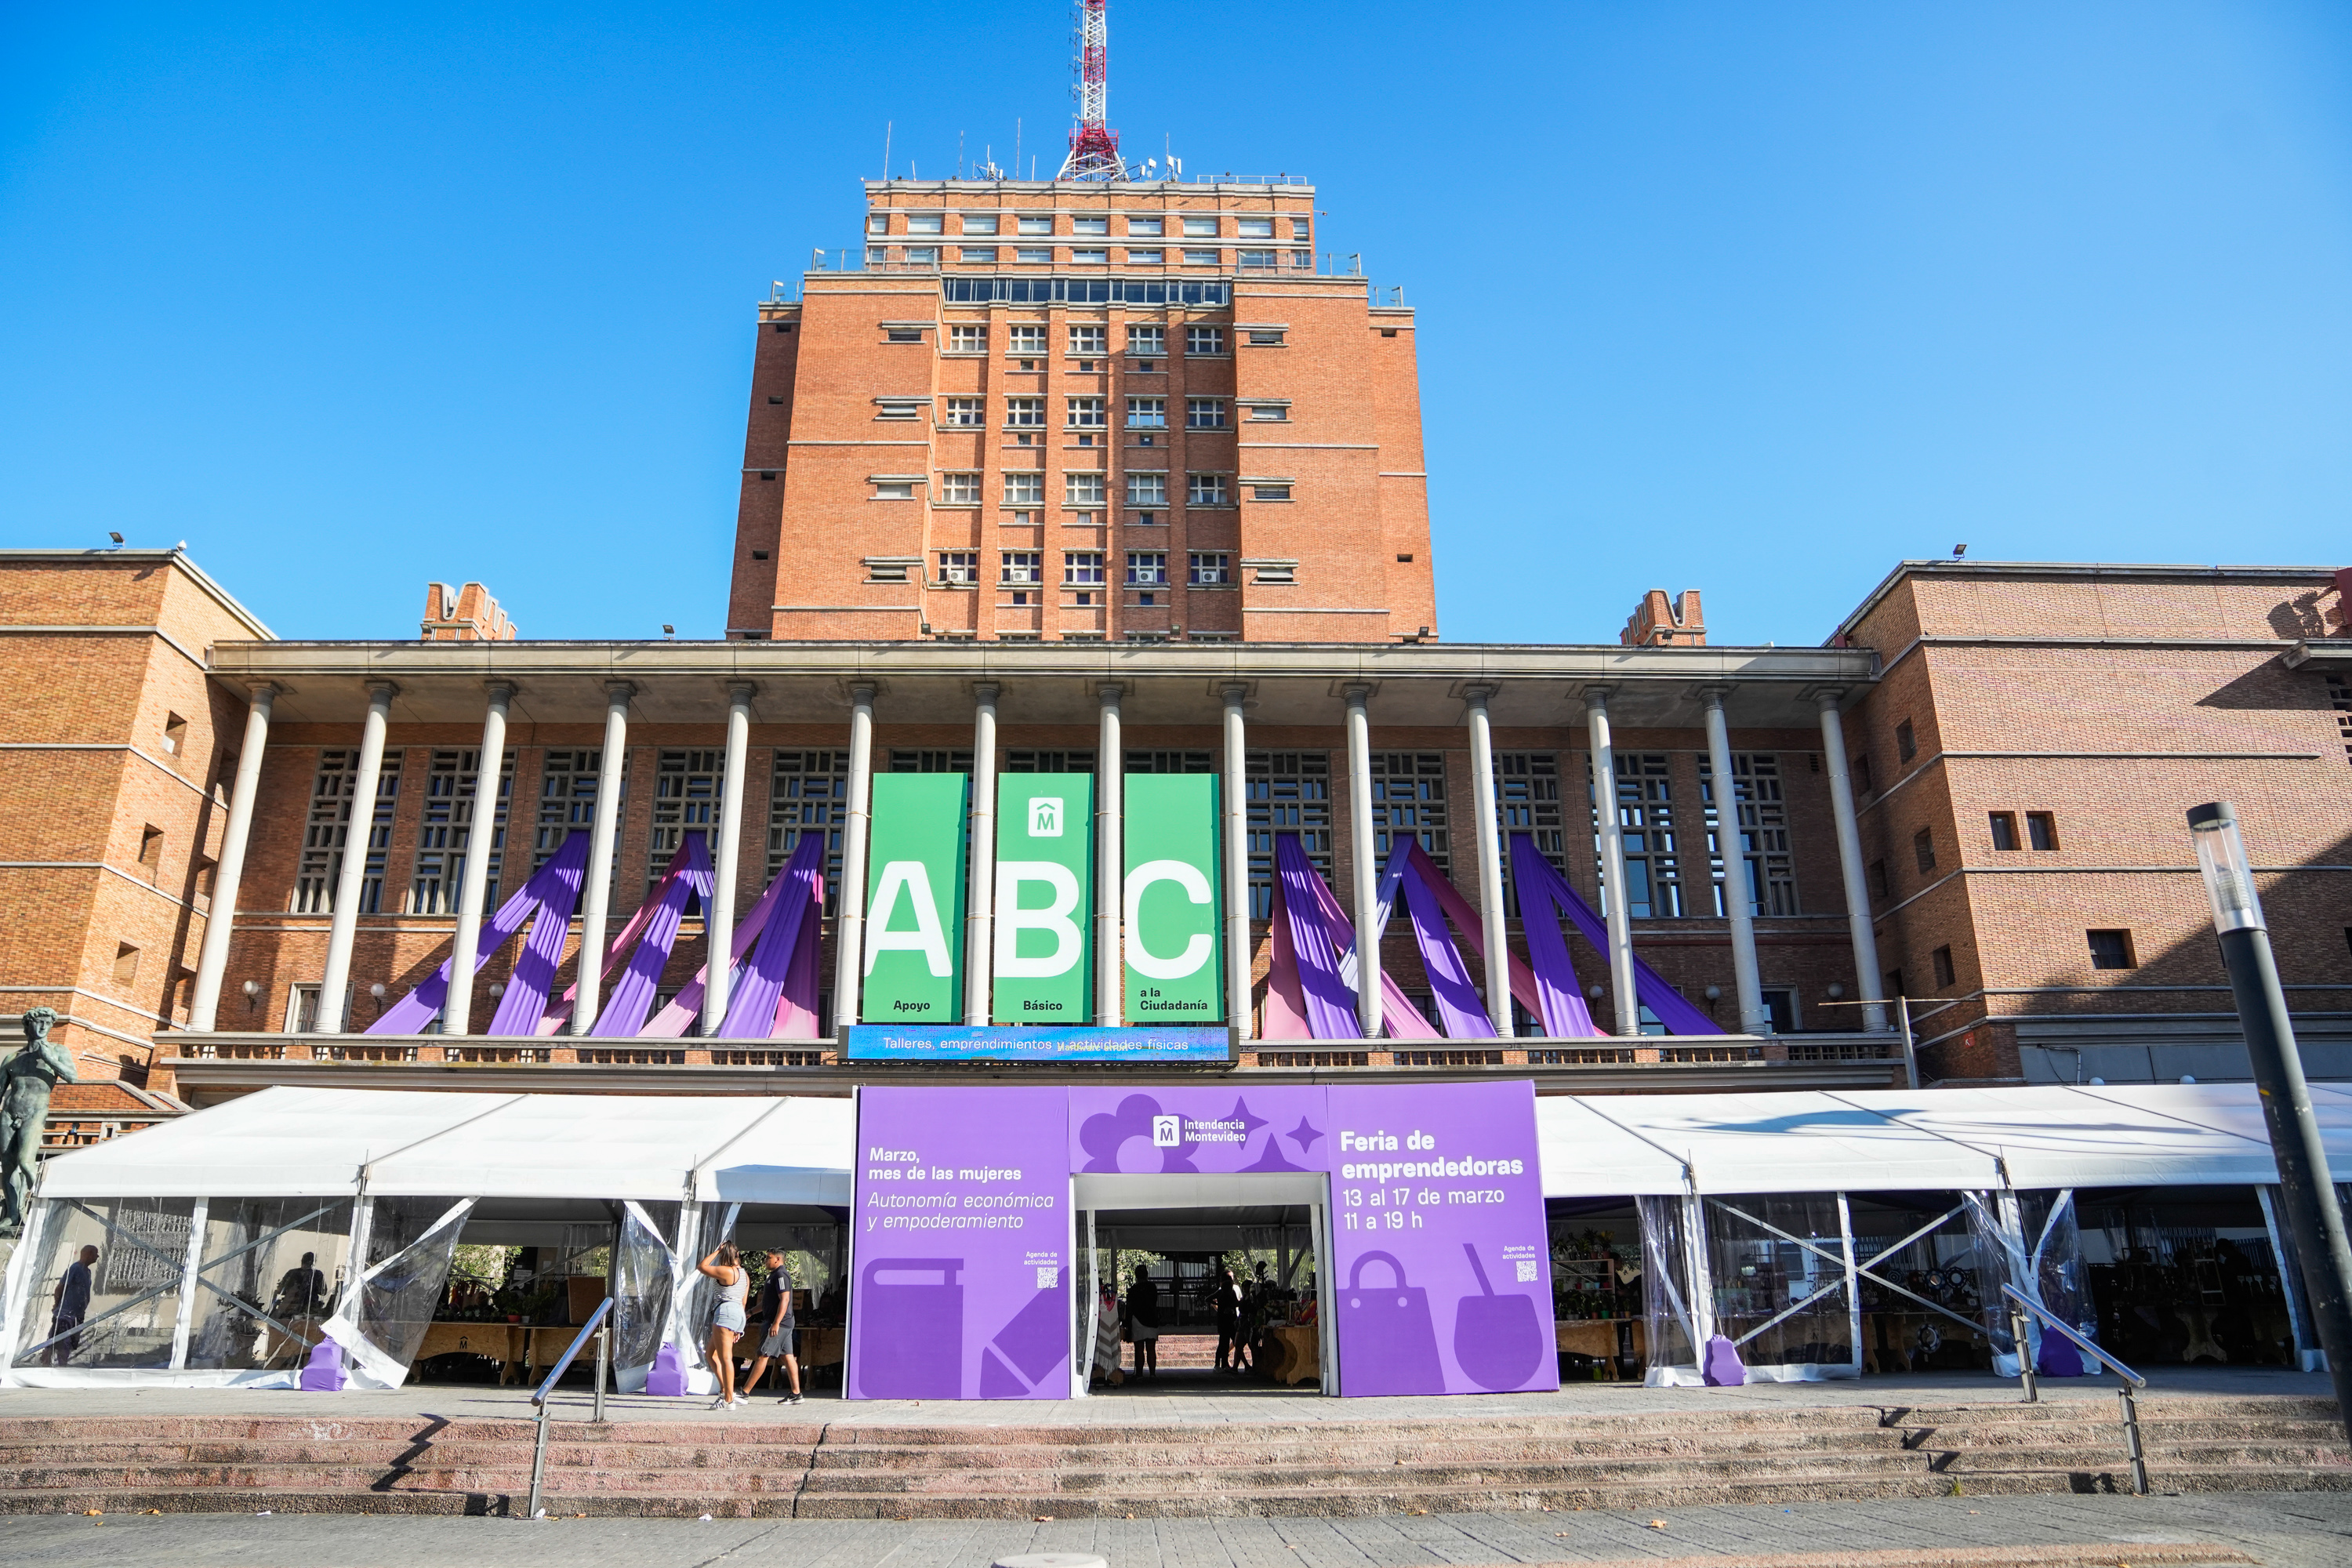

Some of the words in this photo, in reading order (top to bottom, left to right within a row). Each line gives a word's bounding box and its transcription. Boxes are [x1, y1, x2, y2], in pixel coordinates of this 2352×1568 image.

[1037, 813, 1054, 830] M
[1150, 987, 1161, 997] la
[893, 1000, 931, 1013] Apoyo
[1023, 1000, 1063, 1011] Básico
[1140, 1000, 1208, 1011] Ciudadanía
[884, 1038, 935, 1050] Talleres,
[940, 1038, 1052, 1051] emprendimientos
[1057, 1041, 1065, 1052] y
[1069, 1039, 1142, 1050] actividades
[1148, 1039, 1189, 1051] físicas
[1185, 1119, 1245, 1130] Intendencia
[1185, 1131, 1246, 1142] Montevideo
[1340, 1130, 1399, 1152] Feria
[1407, 1129, 1435, 1151] de
[869, 1147, 920, 1164] Marzo,
[868, 1168, 901, 1181] mes
[906, 1165, 926, 1181] de
[931, 1165, 953, 1181] las
[959, 1165, 1022, 1184] mujeres
[1341, 1156, 1524, 1184] emprendedoras
[867, 1192, 957, 1208] Autonomía
[964, 1192, 1054, 1208] económica
[1343, 1189, 1363, 1207] 13
[1370, 1188, 1386, 1207] al
[1392, 1187, 1410, 1206] 17
[1417, 1187, 1441, 1206] de
[1448, 1189, 1505, 1204] marzo
[867, 1217, 878, 1232] y
[883, 1212, 1024, 1232] empoderamiento
[1343, 1212, 1358, 1230] 11
[1366, 1216, 1377, 1230] a
[1383, 1211, 1404, 1229] 19
[1410, 1210, 1423, 1229] h
[1025, 1251, 1047, 1260] Agenda
[1502, 1251, 1536, 1260] actividades
[1504, 1245, 1524, 1254] Agenda
